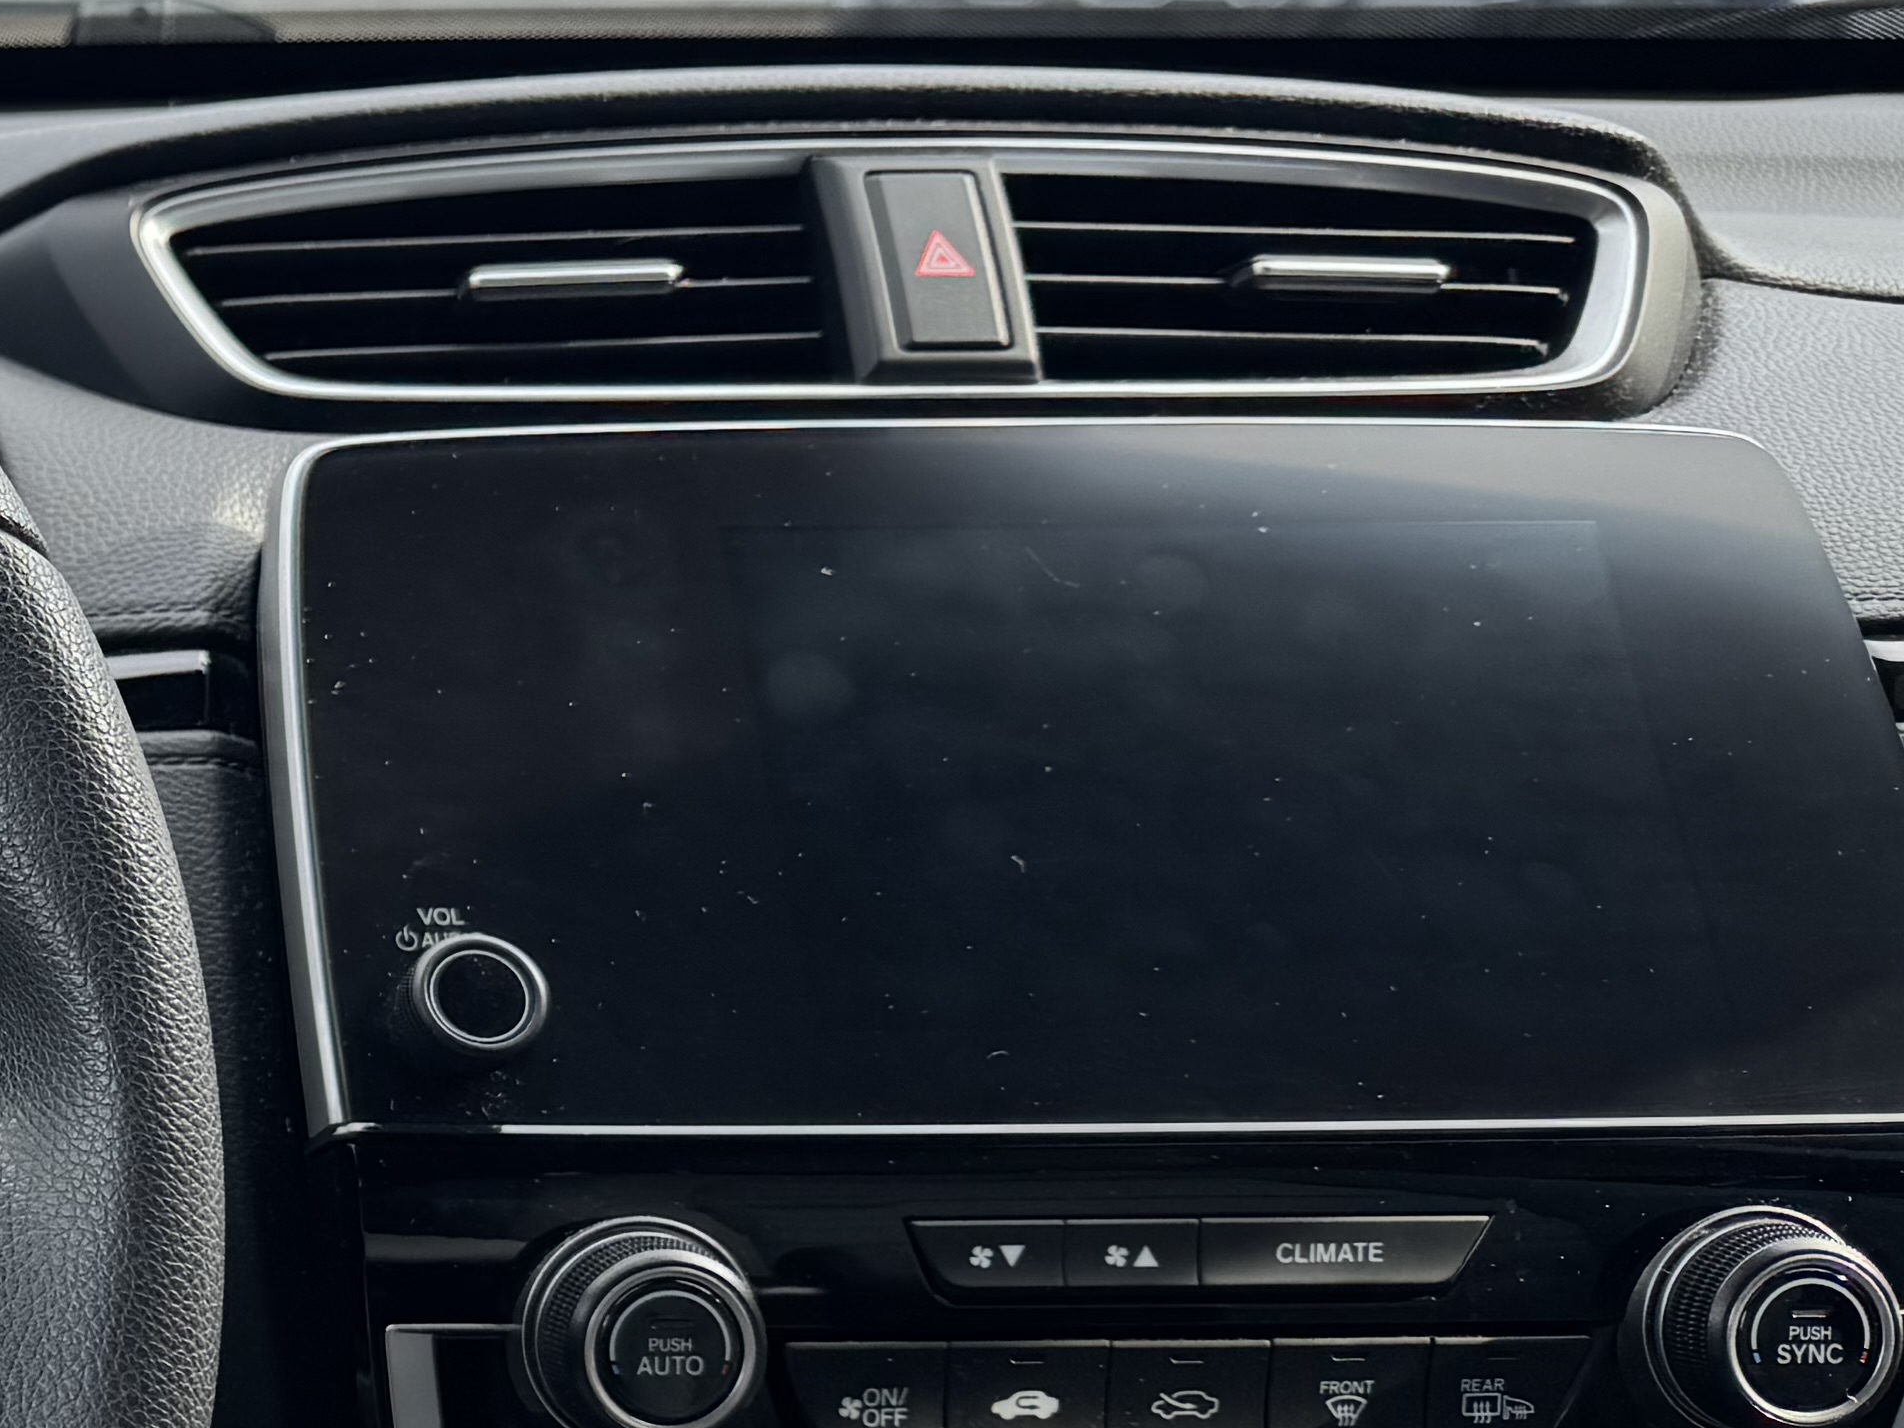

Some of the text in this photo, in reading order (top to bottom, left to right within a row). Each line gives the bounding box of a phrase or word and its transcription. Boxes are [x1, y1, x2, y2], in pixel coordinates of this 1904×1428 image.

[416, 907, 465, 926] VOL
[1275, 1242, 1384, 1264] CLIMATE
[1788, 1325, 1832, 1341] PUSH
[648, 1337, 692, 1352] PUSH
[1777, 1343, 1844, 1364] SYNC
[636, 1356, 704, 1376] AUTO
[1319, 1380, 1375, 1394] FRONT
[1461, 1378, 1505, 1392] REAR
[862, 1387, 909, 1407] ON/
[862, 1407, 908, 1428] OFF
